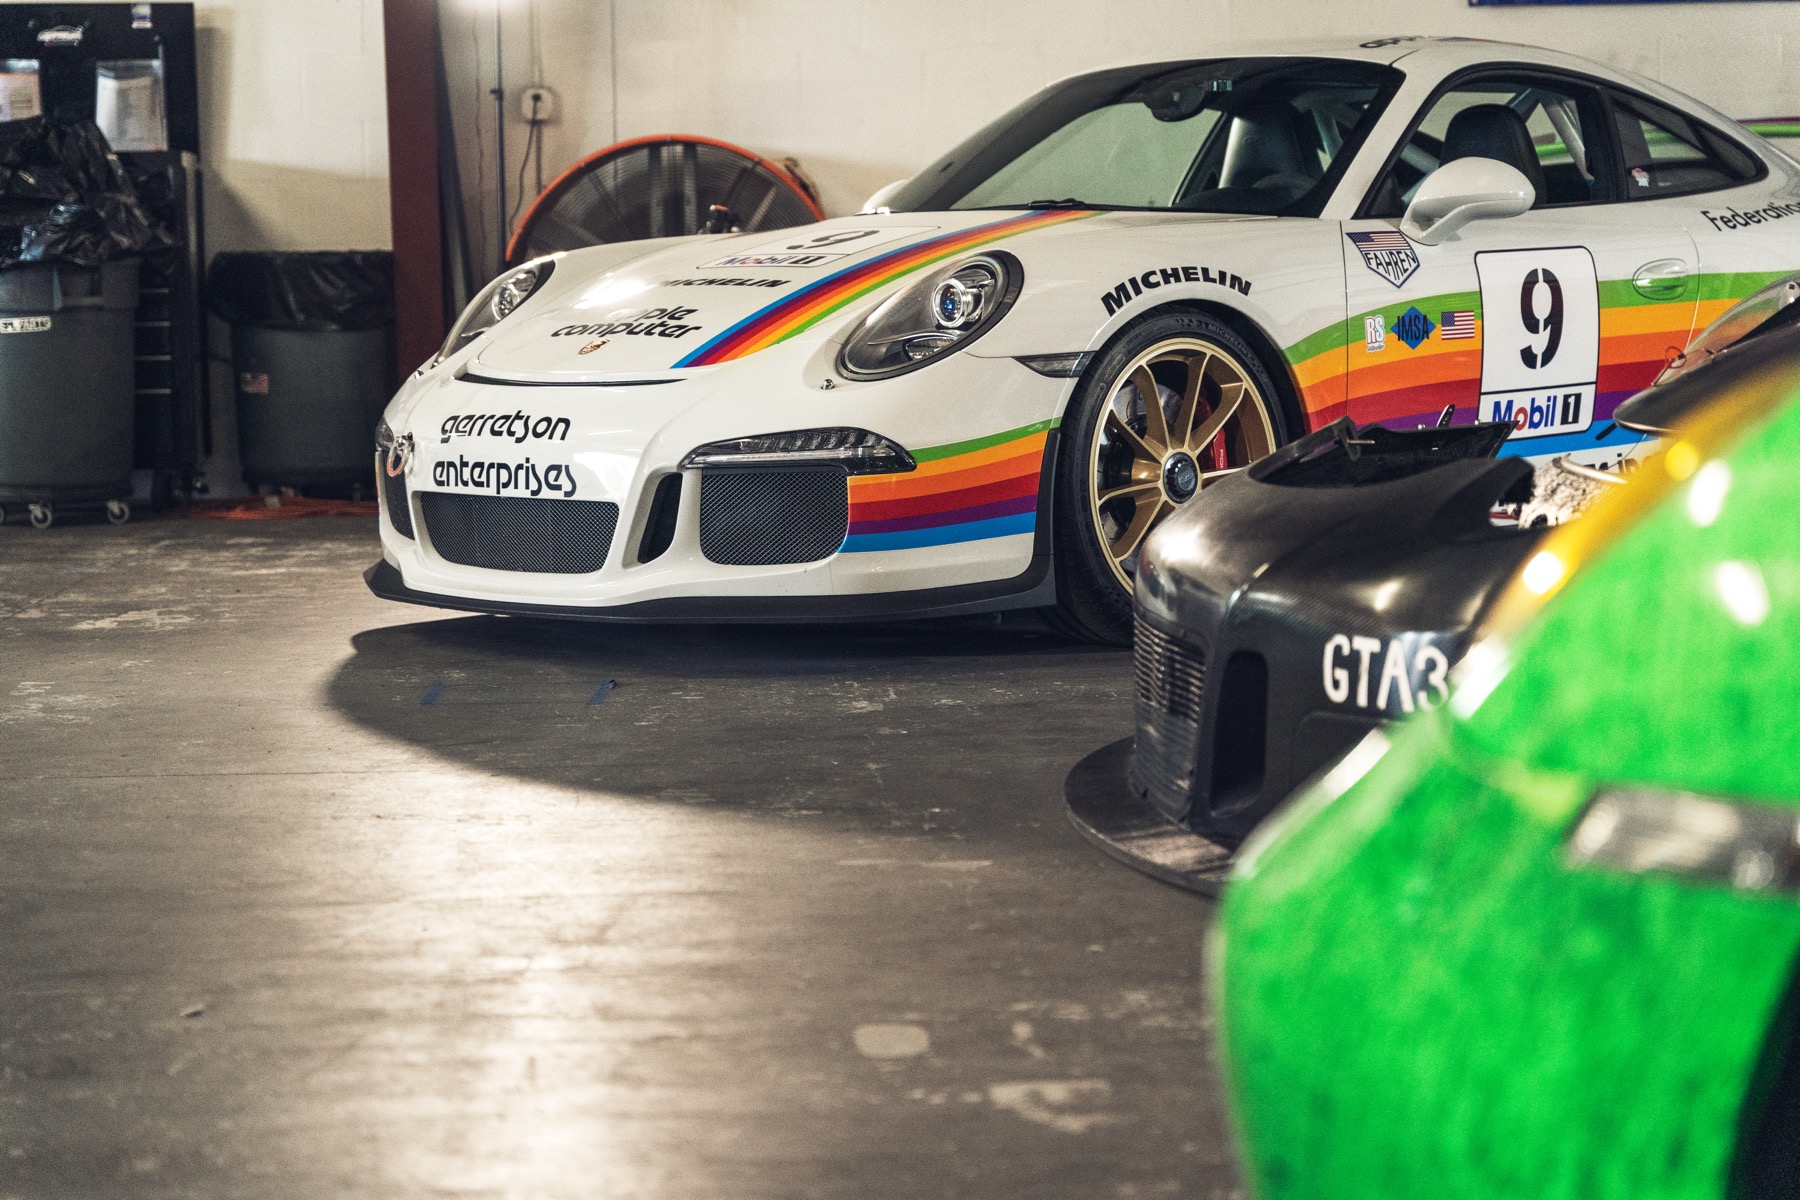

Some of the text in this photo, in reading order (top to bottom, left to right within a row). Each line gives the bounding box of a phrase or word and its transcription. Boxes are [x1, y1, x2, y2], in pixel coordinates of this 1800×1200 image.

[1364, 250, 1417, 281] FAHREN
[1100, 266, 1252, 317] MICHELIN
[551, 320, 703, 339] computer
[1365, 314, 1385, 345] RS
[1397, 314, 1430, 341] IMSA
[1519, 267, 1564, 370] 9
[1492, 394, 1558, 431] Mobil
[432, 454, 578, 498] enterprises
[1322, 633, 1449, 712] GTA3
